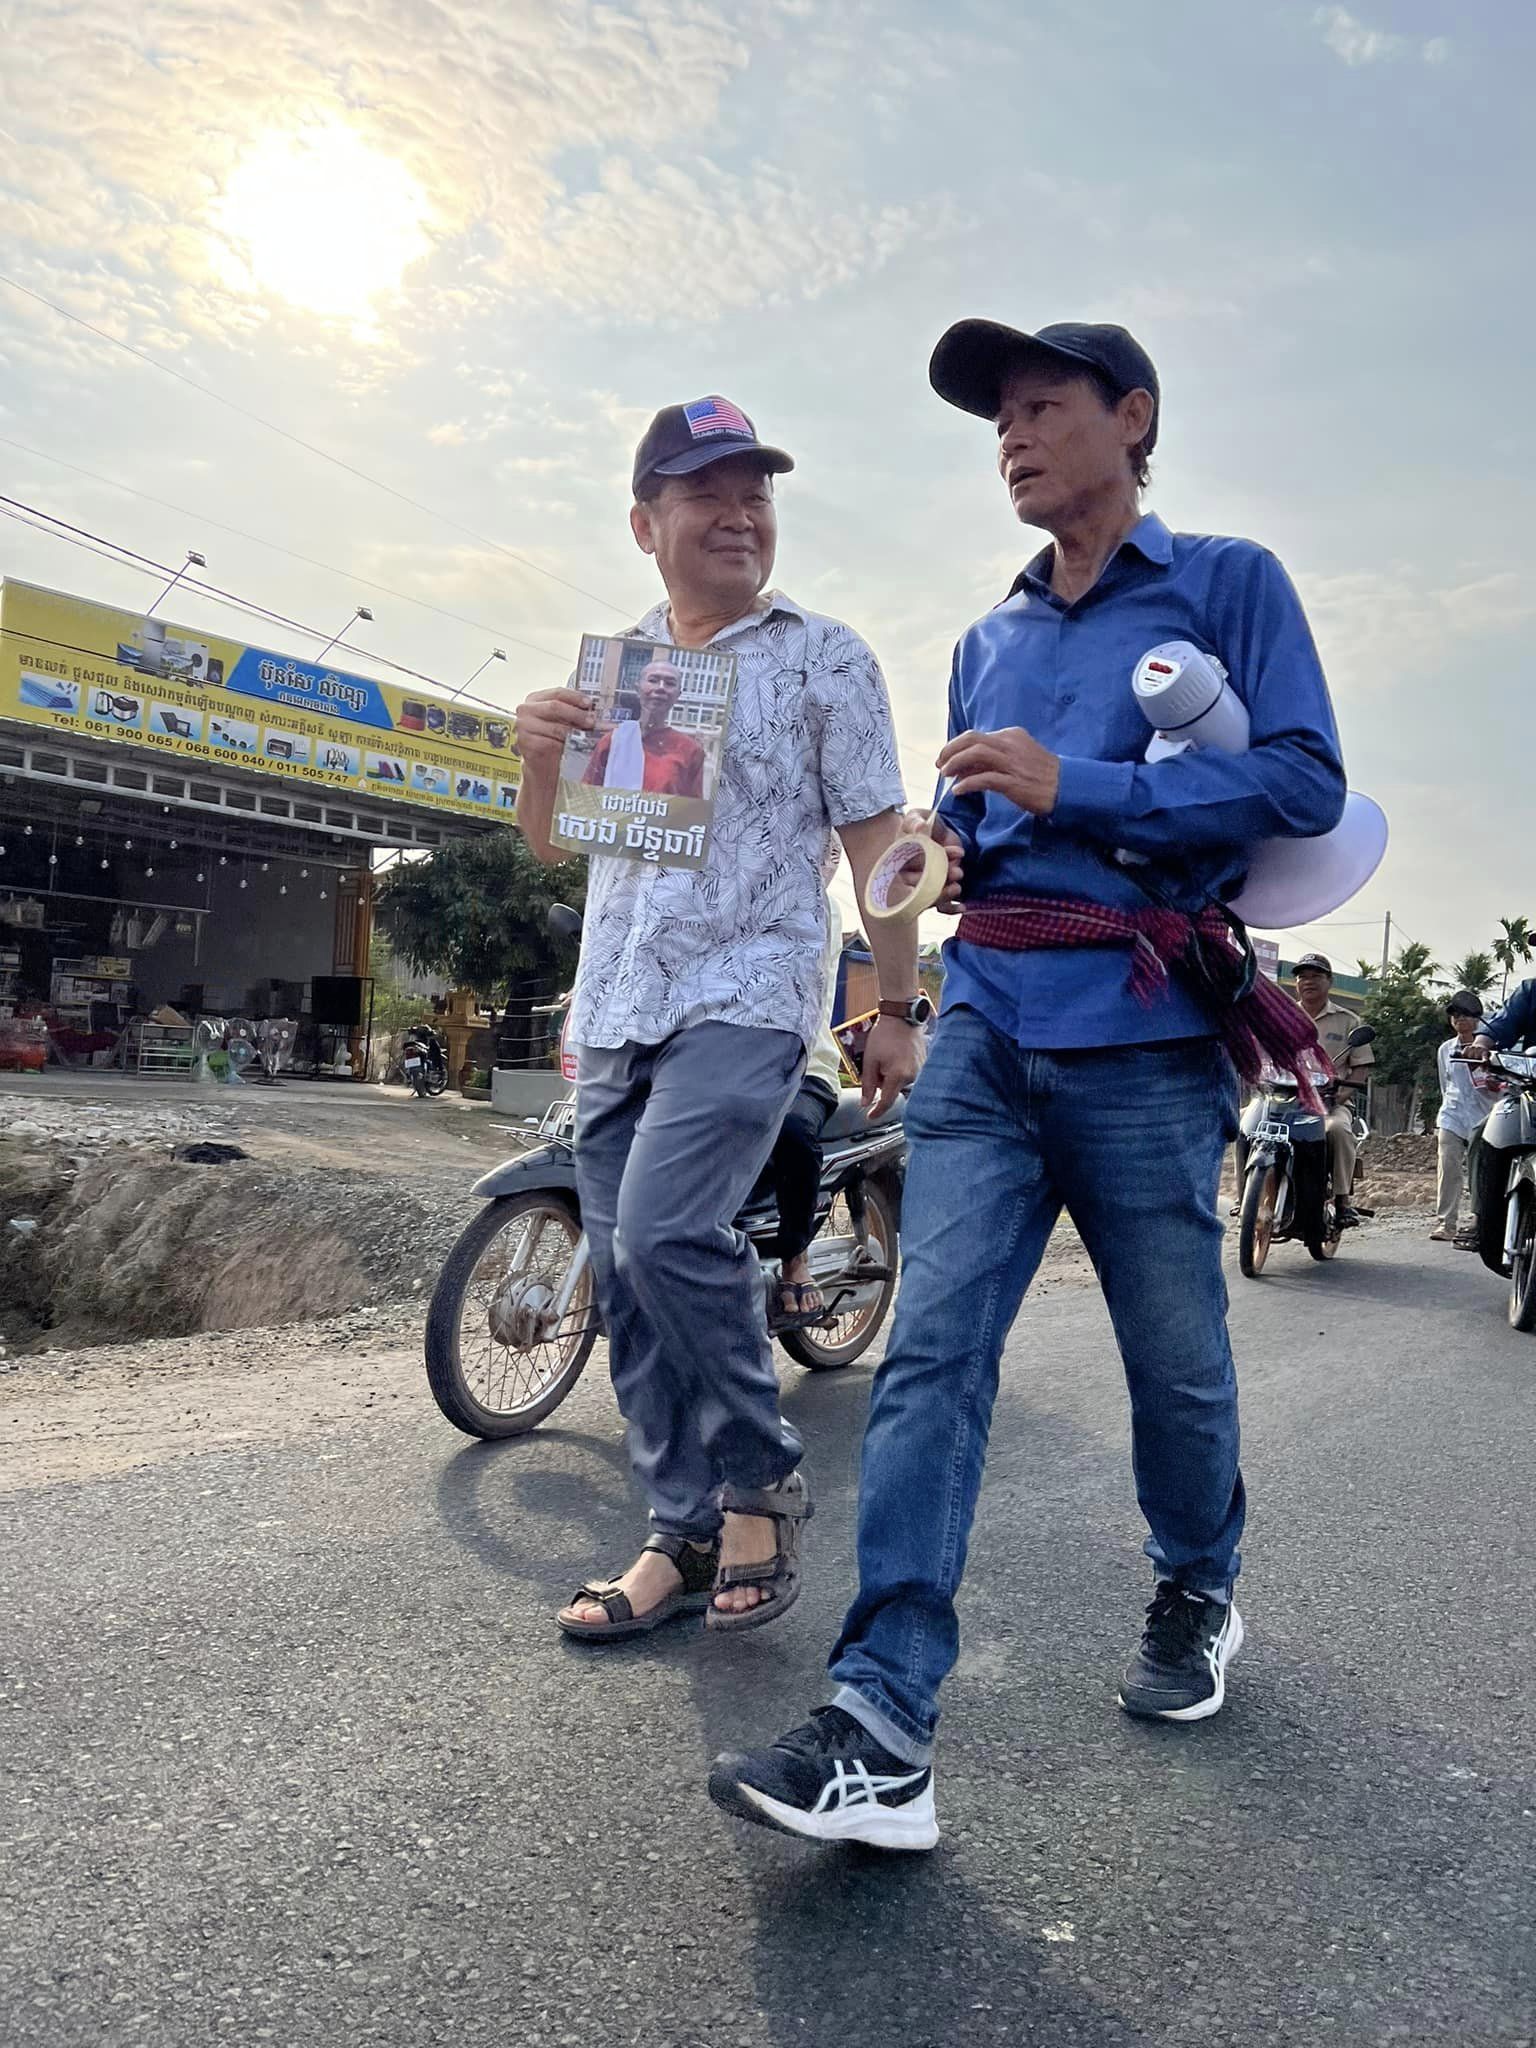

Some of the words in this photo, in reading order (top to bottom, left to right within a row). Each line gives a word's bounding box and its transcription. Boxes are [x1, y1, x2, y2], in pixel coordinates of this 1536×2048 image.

[51, 712, 79, 727] Tel:
[85, 720, 110, 734] 061
[116, 727, 143, 740] 900
[147, 734, 173, 747] 065
[185, 743, 209, 755] 068
[214, 748, 238, 761] 600
[242, 754, 265, 766] 040
[276, 761, 297, 774] 011
[302, 767, 324, 779] 505
[328, 771, 349, 783] 747
[602, 793, 668, 817] ដោះលែង
[558, 812, 617, 844] សេង
[625, 816, 706, 861] ច័ន្ទធារី
